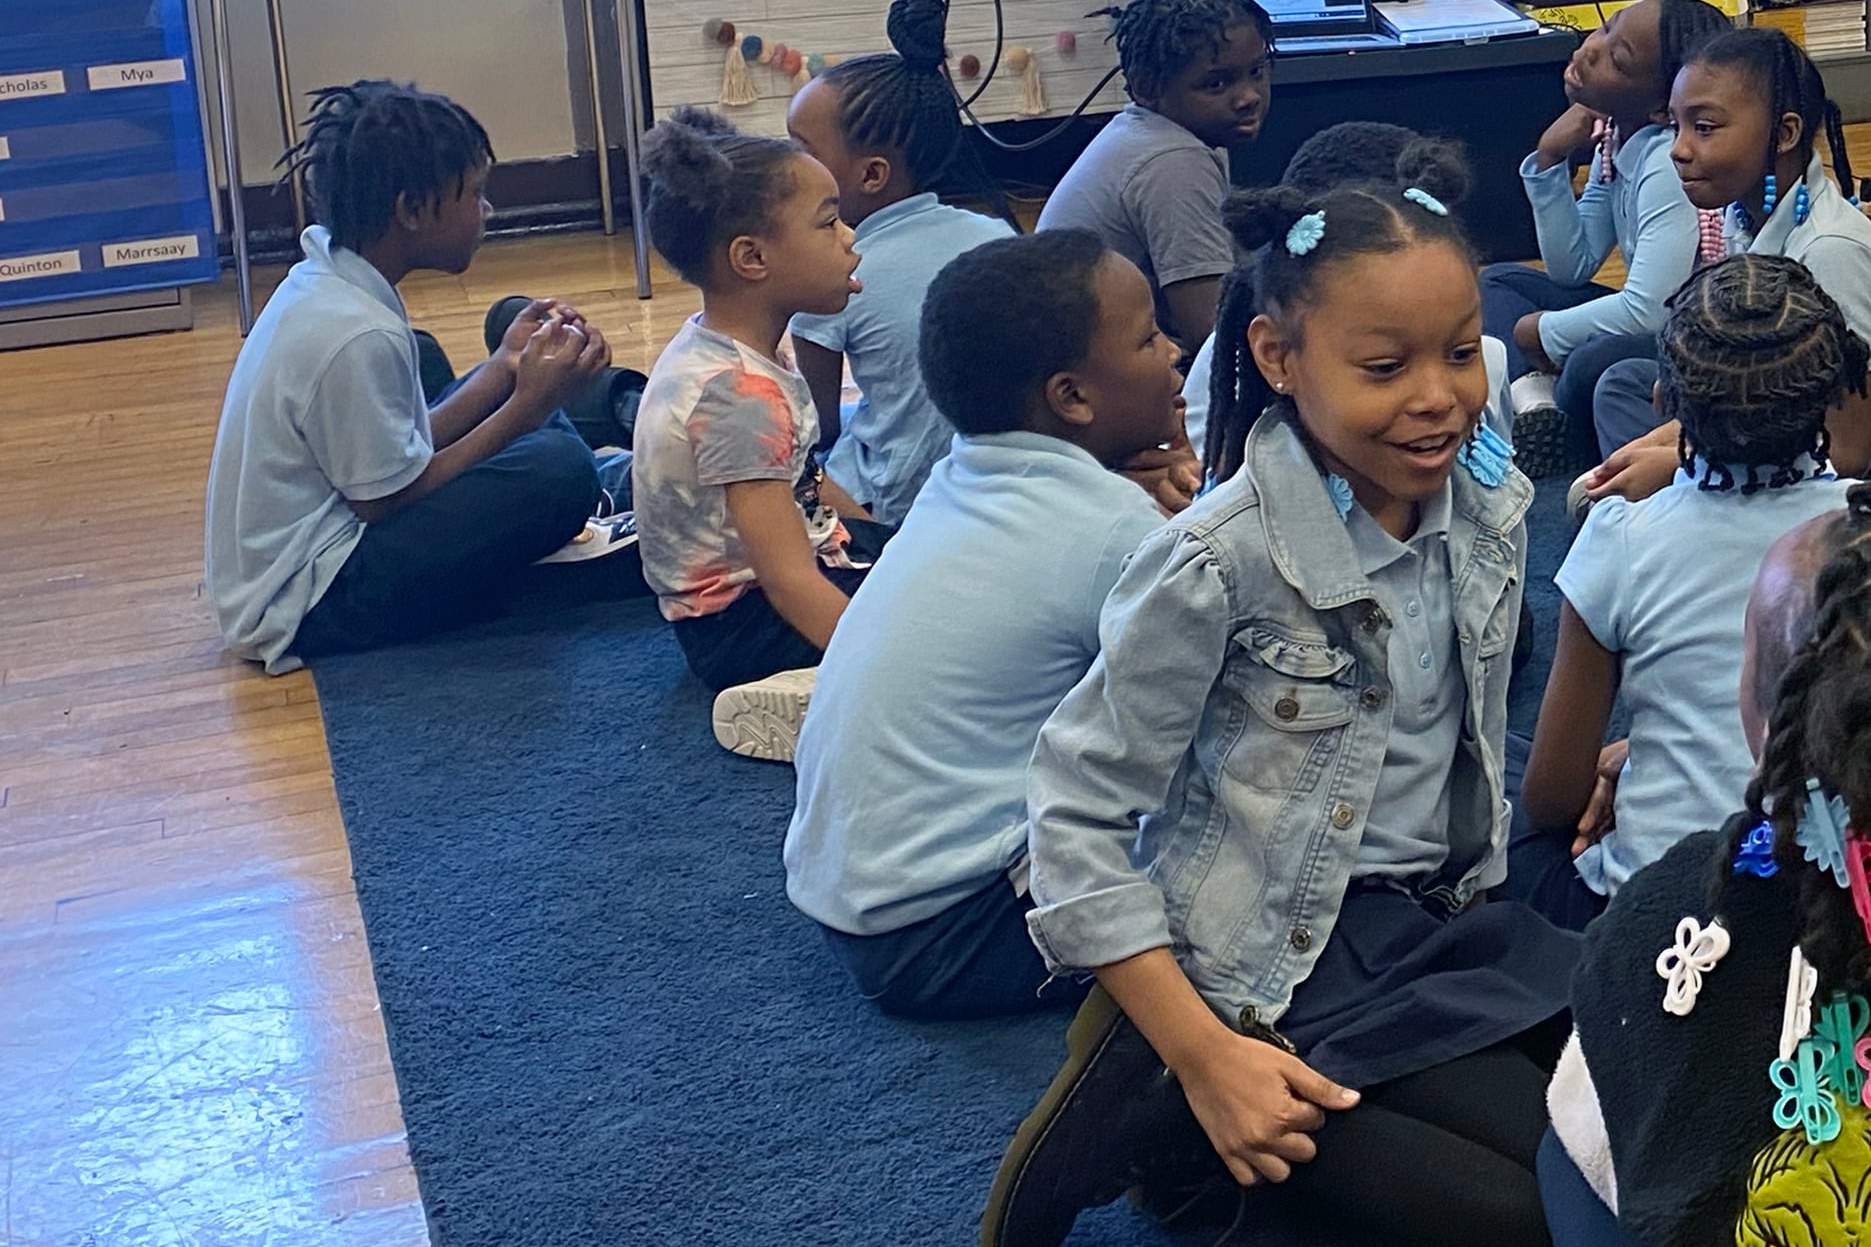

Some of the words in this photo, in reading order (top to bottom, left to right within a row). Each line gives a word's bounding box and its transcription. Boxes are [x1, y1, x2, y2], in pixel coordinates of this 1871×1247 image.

[121, 68, 153, 82] Mya
[116, 244, 186, 261] Marrsaay
[0, 258, 62, 277] Quinton
